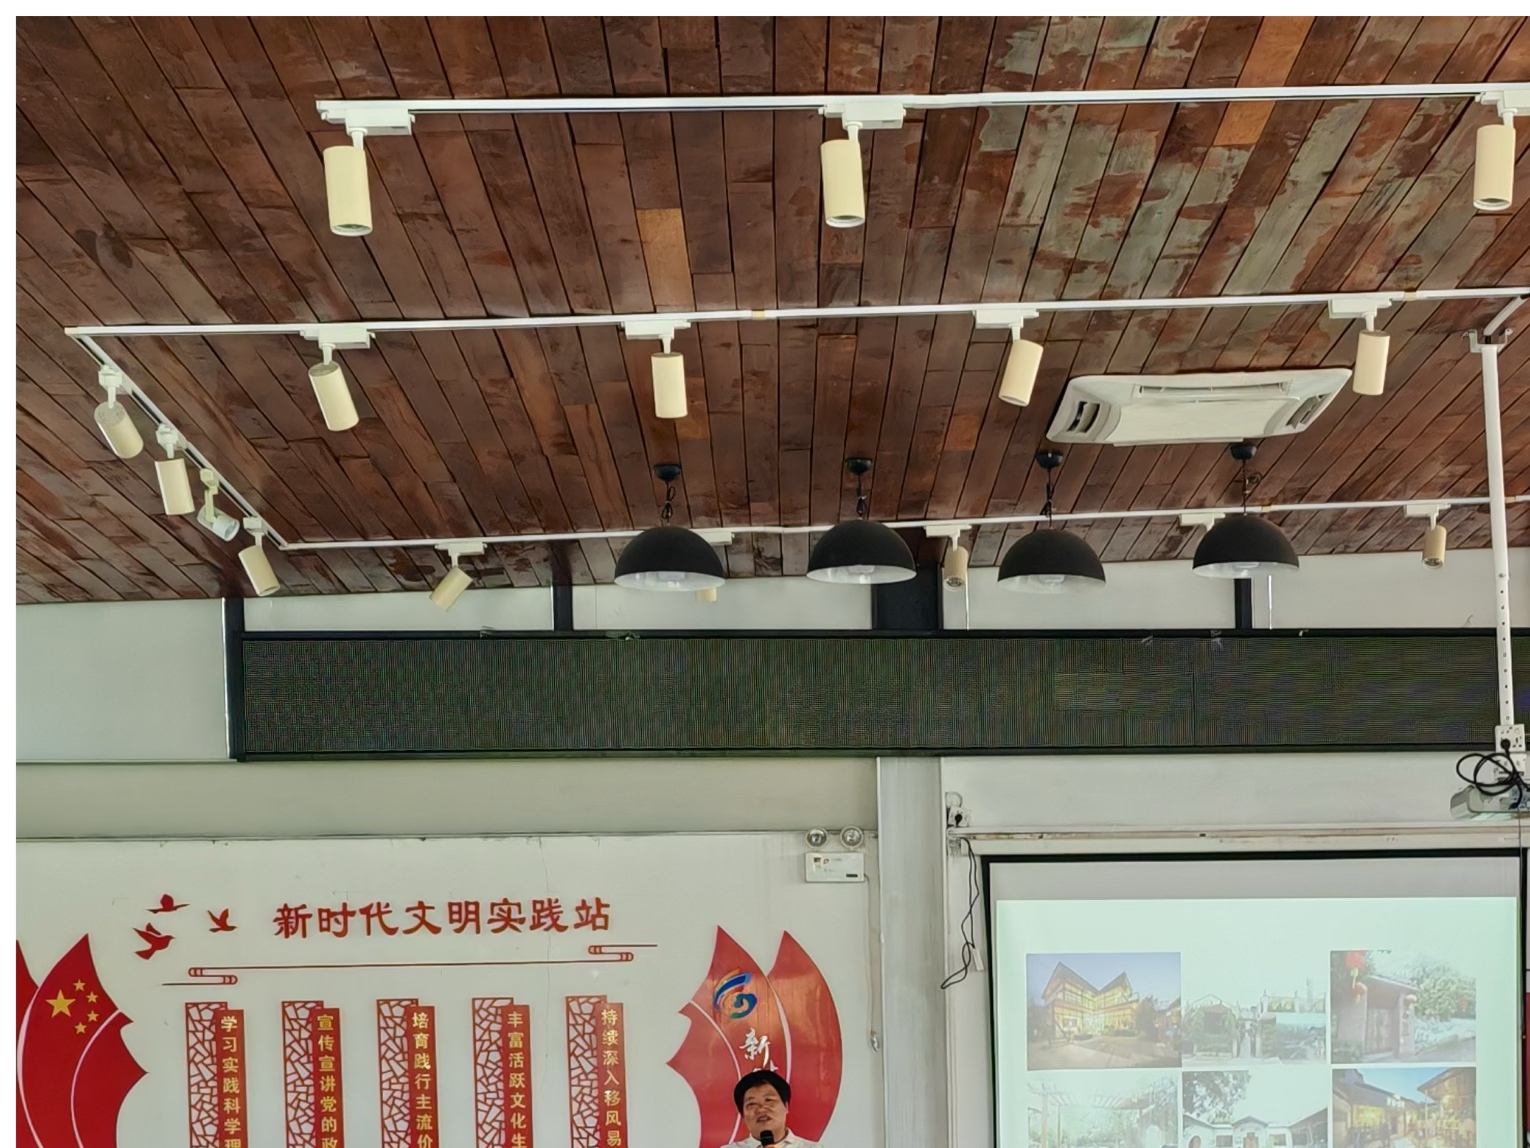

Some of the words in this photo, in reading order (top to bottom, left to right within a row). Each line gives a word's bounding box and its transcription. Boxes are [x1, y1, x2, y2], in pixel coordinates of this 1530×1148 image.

[273, 897, 611, 938] 新时代文明实践站
